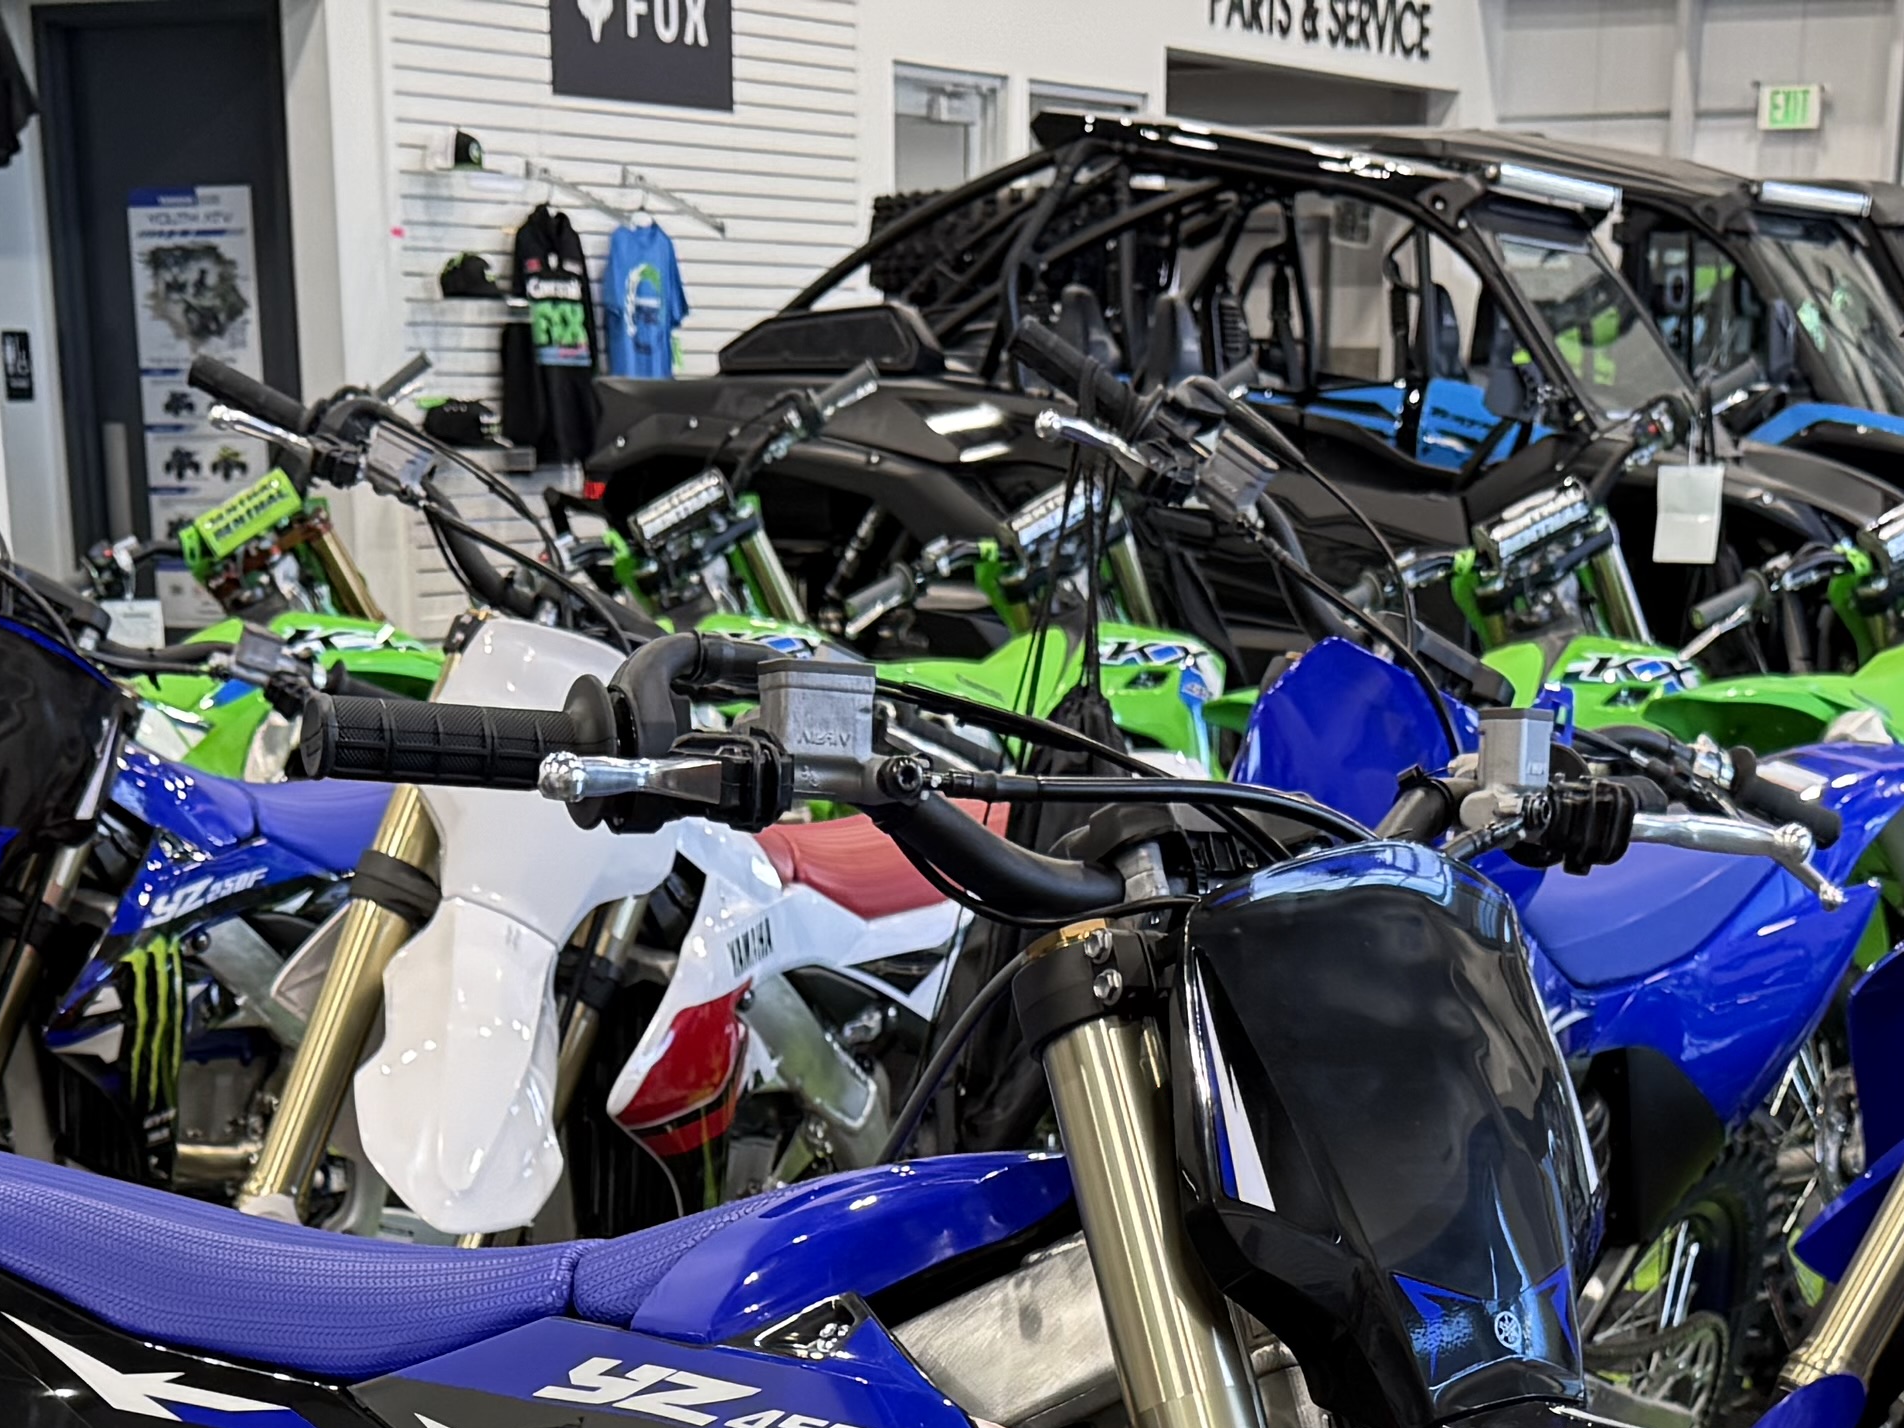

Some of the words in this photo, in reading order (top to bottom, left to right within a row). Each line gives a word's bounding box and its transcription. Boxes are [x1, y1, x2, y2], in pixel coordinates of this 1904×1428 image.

[1327, 0, 1431, 61] SERVICE
[1769, 89, 1810, 126] EXIT
[726, 916, 774, 979] YAMAHA
